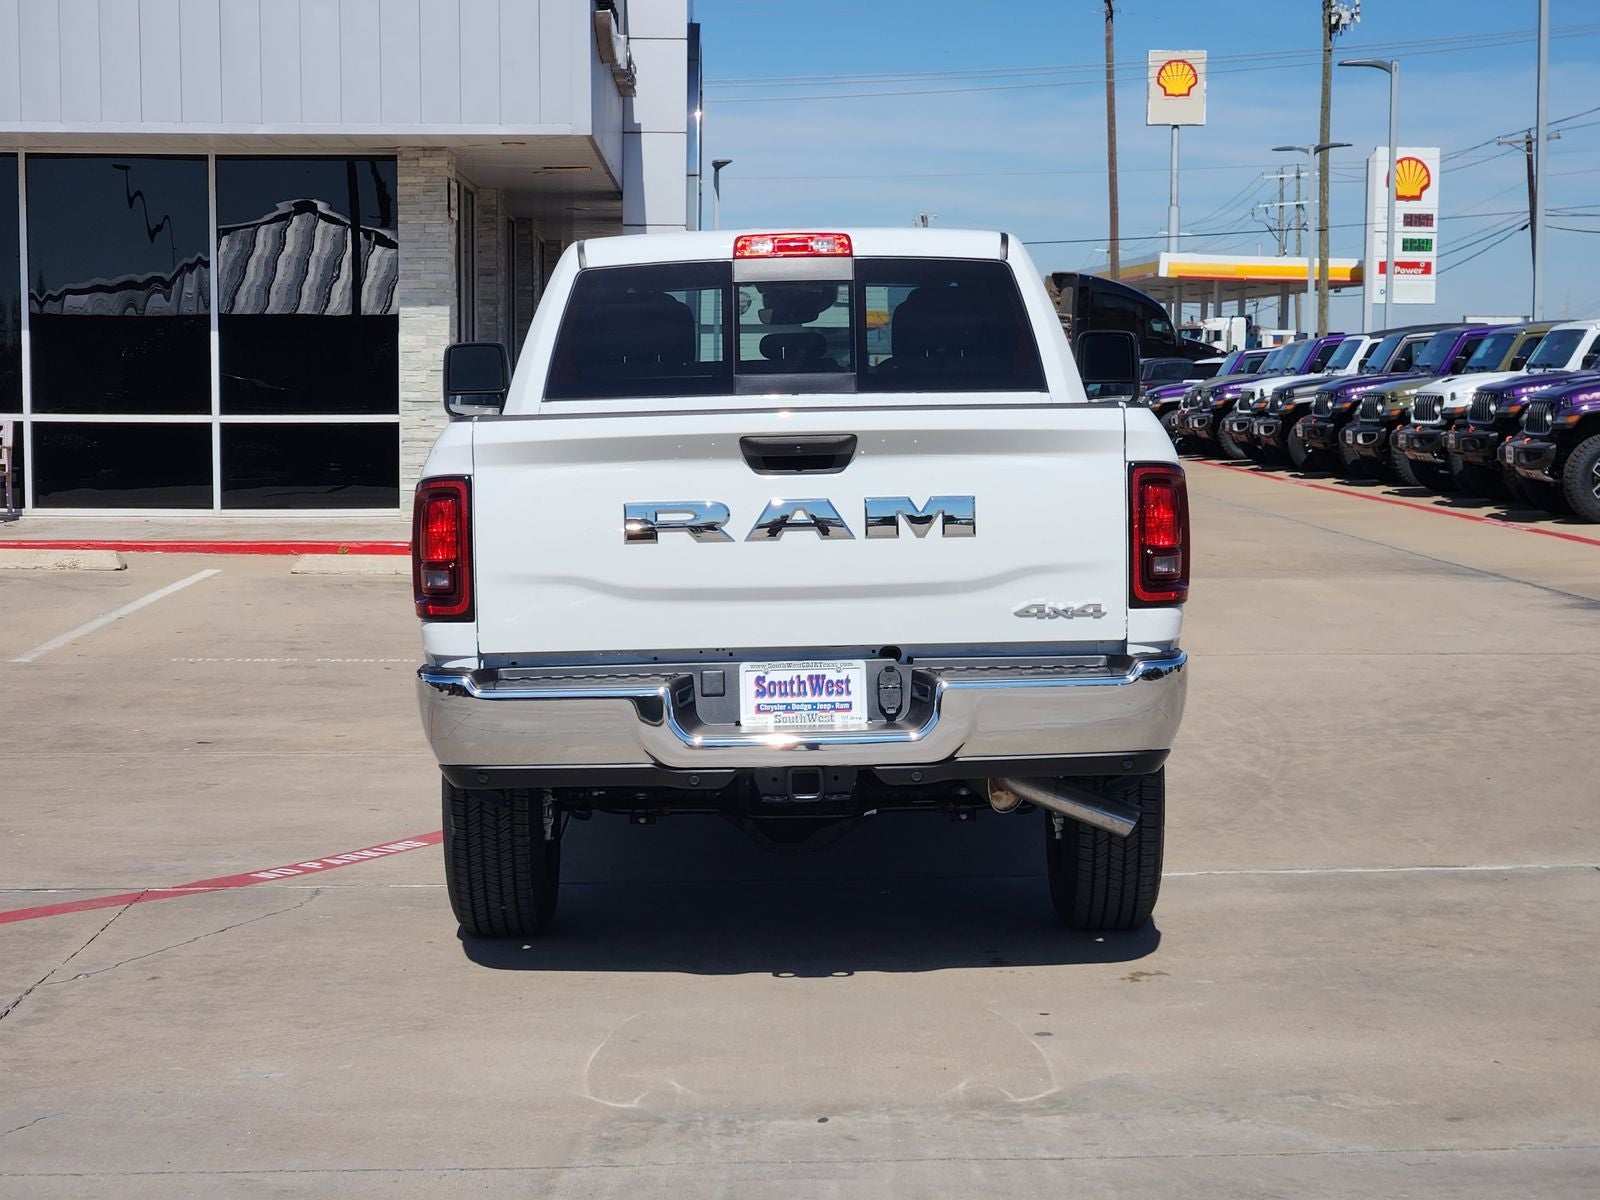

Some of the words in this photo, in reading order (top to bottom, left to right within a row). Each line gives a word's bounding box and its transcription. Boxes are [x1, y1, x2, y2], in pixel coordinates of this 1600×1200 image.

[1394, 266, 1424, 275] Power
[623, 495, 977, 545] RAM
[1013, 599, 1109, 620] 4x4
[754, 674, 852, 698] SouthWest
[759, 703, 787, 712] Chrysler
[791, 703, 812, 711] Dodge
[816, 702, 832, 711] Jeep
[835, 702, 850, 710] Ram
[774, 713, 835, 723] SouthWest
[249, 868, 304, 879] NO
[298, 840, 429, 869] PARKING
